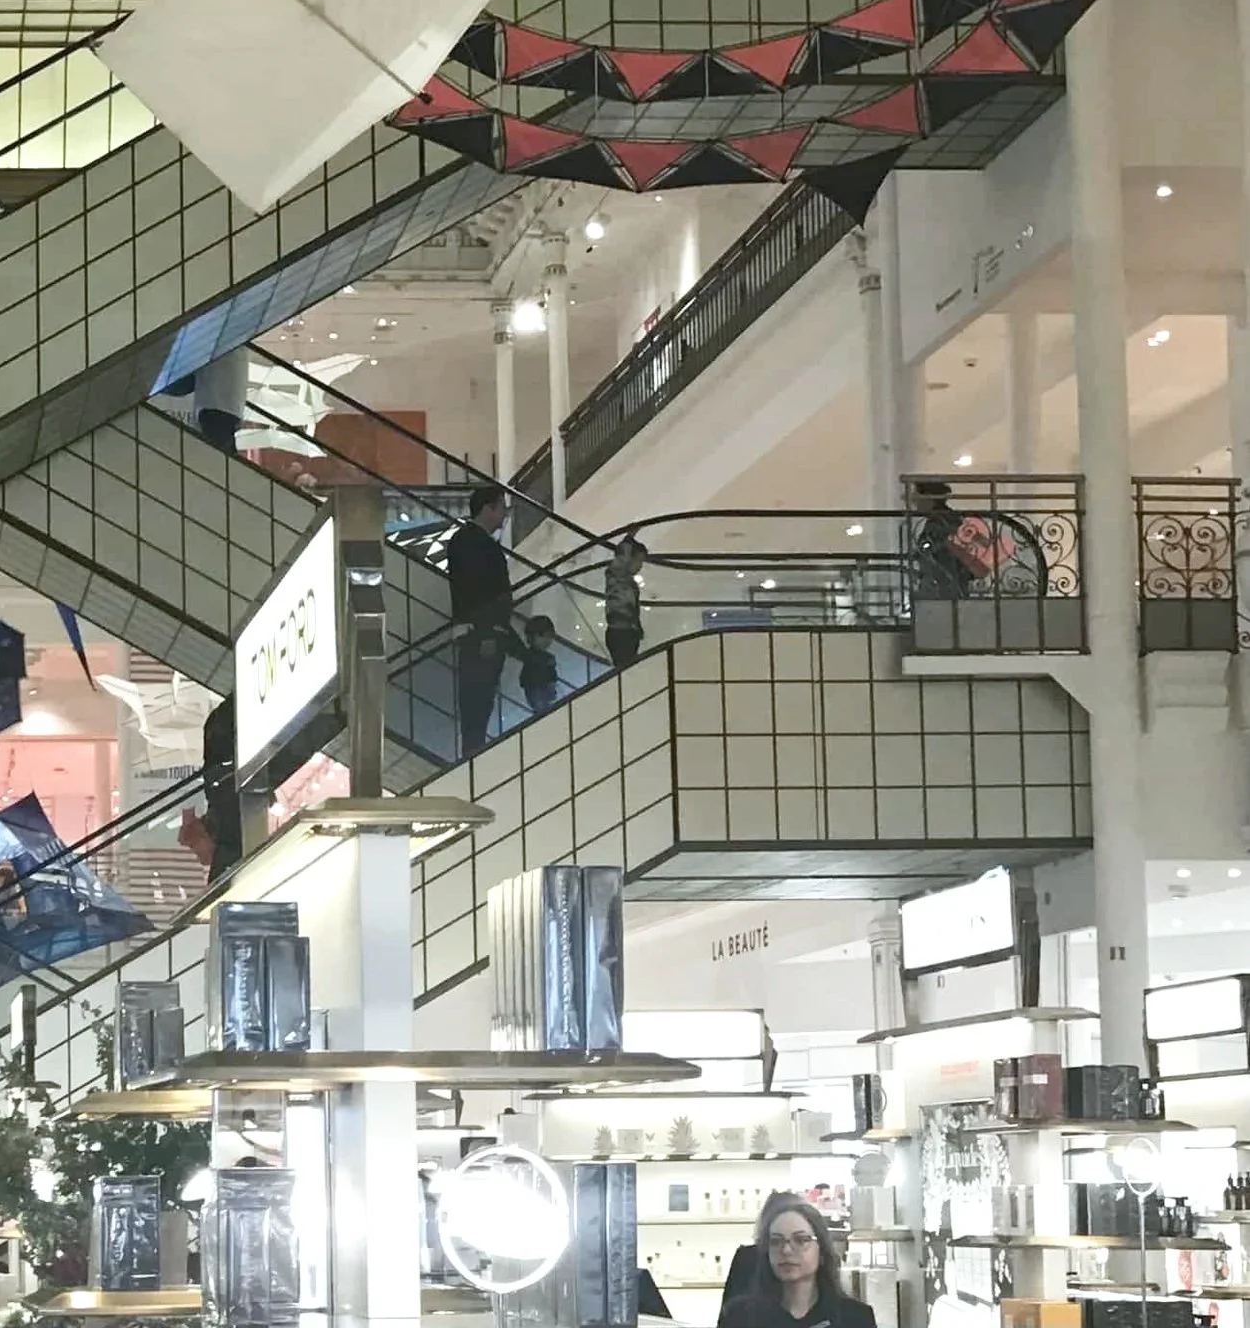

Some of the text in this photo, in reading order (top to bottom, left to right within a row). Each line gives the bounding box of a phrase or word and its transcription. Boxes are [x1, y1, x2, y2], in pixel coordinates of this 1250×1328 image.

[251, 588, 316, 705] TOM FORD
[712, 920, 769, 961] LA BEAUTÉ
